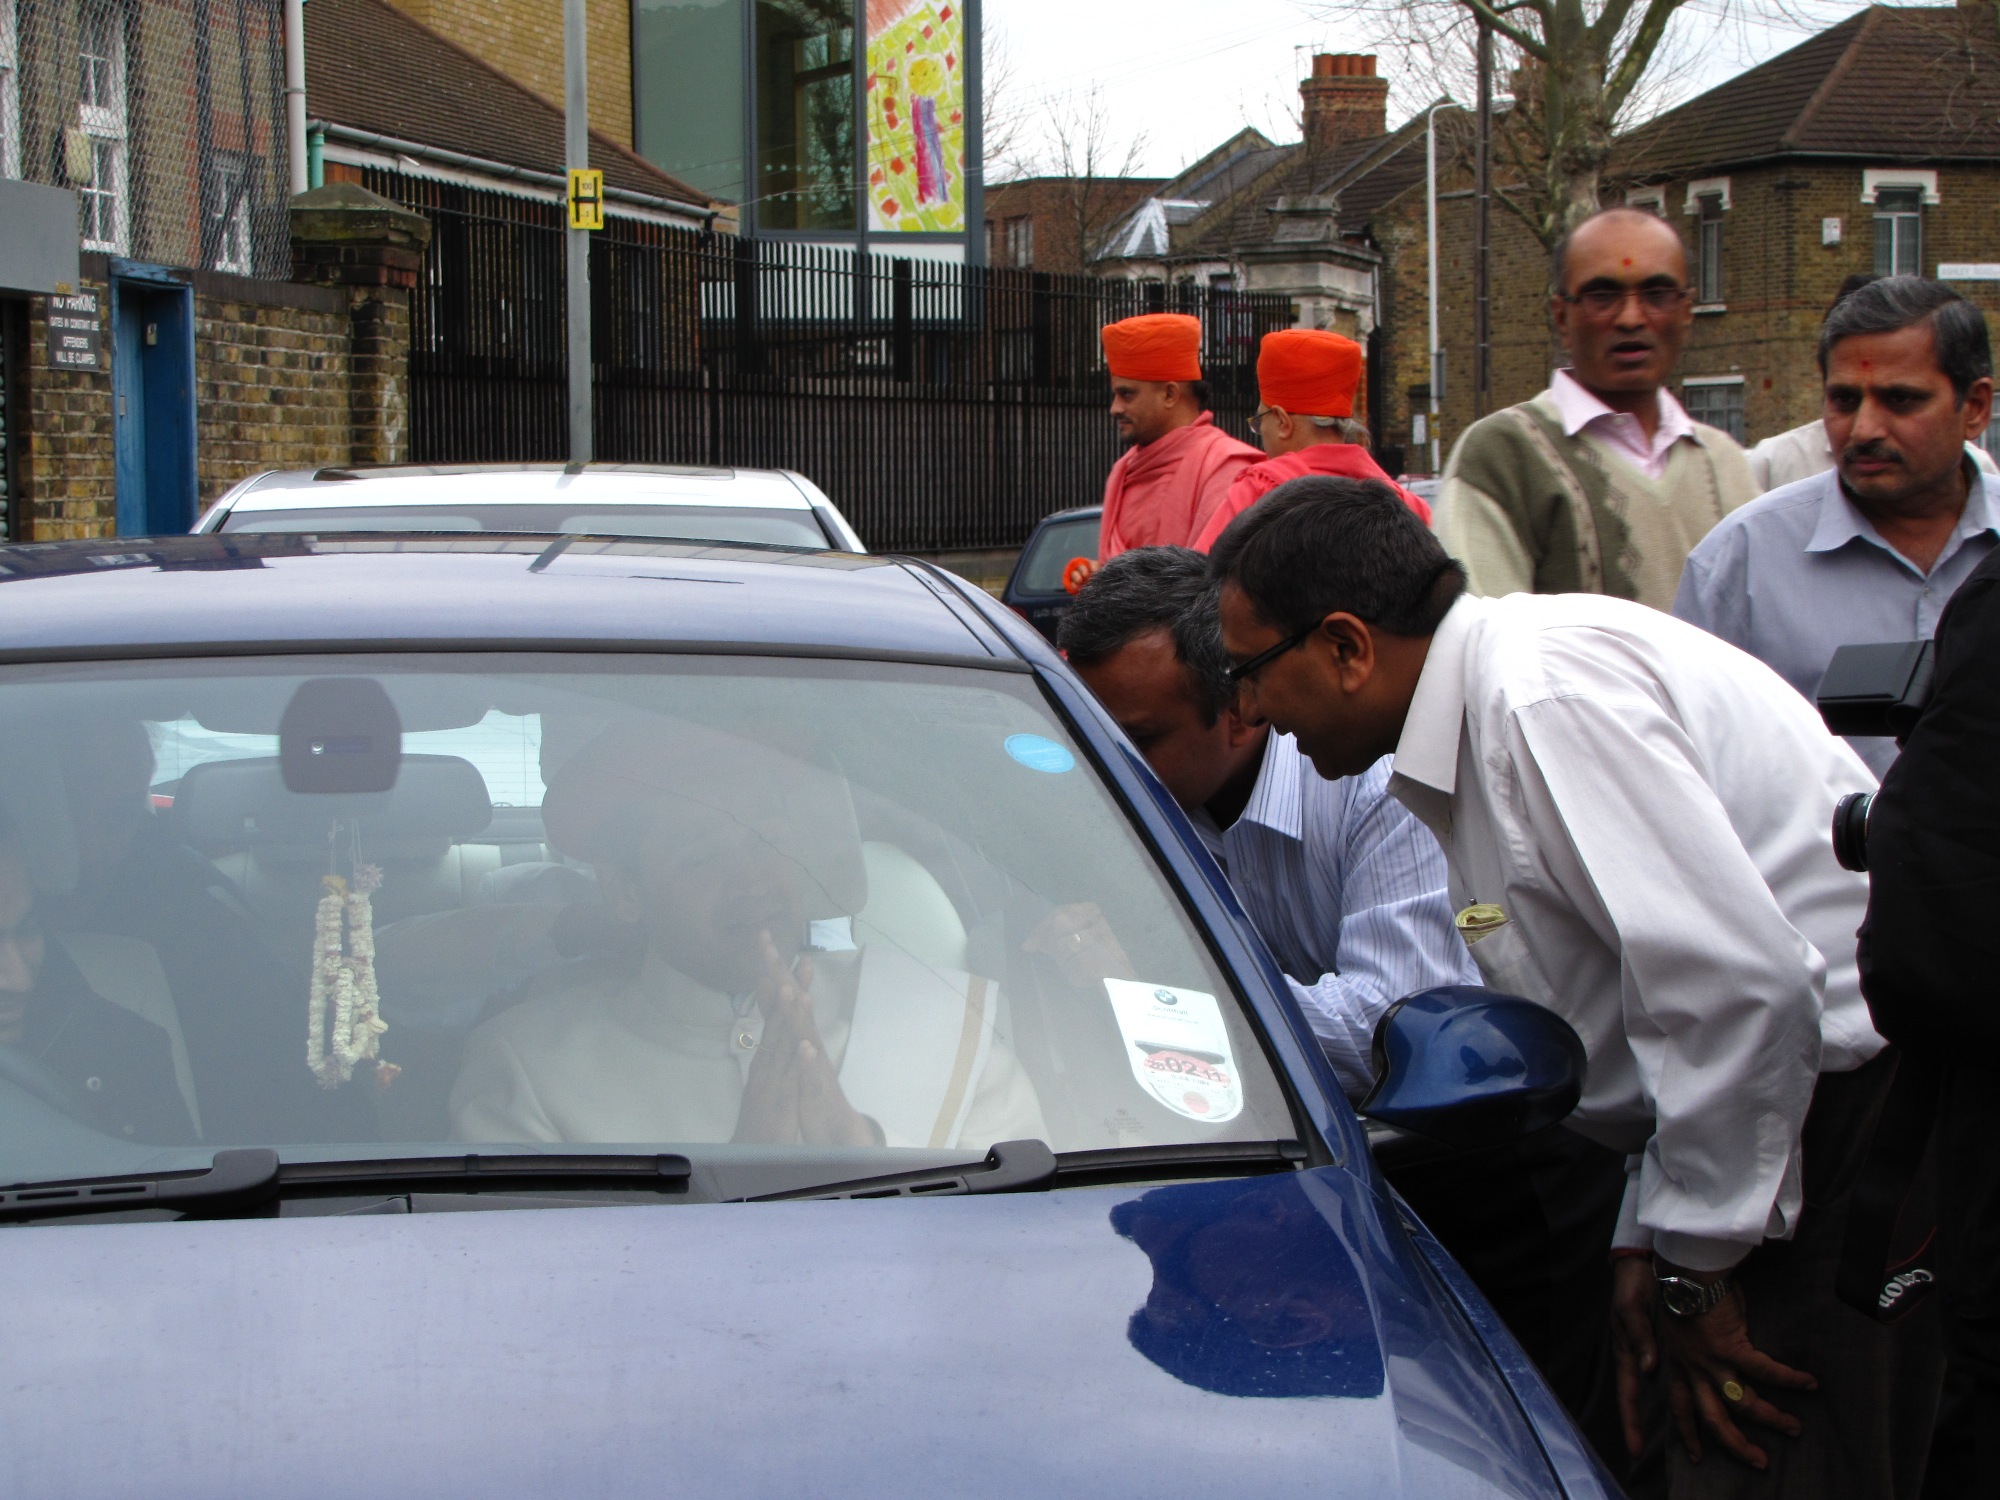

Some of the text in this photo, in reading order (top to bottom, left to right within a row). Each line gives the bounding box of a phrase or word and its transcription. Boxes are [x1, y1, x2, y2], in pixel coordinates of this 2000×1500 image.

[52, 294, 96, 313] NO PARKING
[50, 316, 64, 328] GATES
[70, 318, 91, 331] CONSTANT
[91, 321, 100, 331] USE
[63, 336, 88, 349] OFFENDERS
[56, 351, 96, 365] WILL BE CLAMPED
